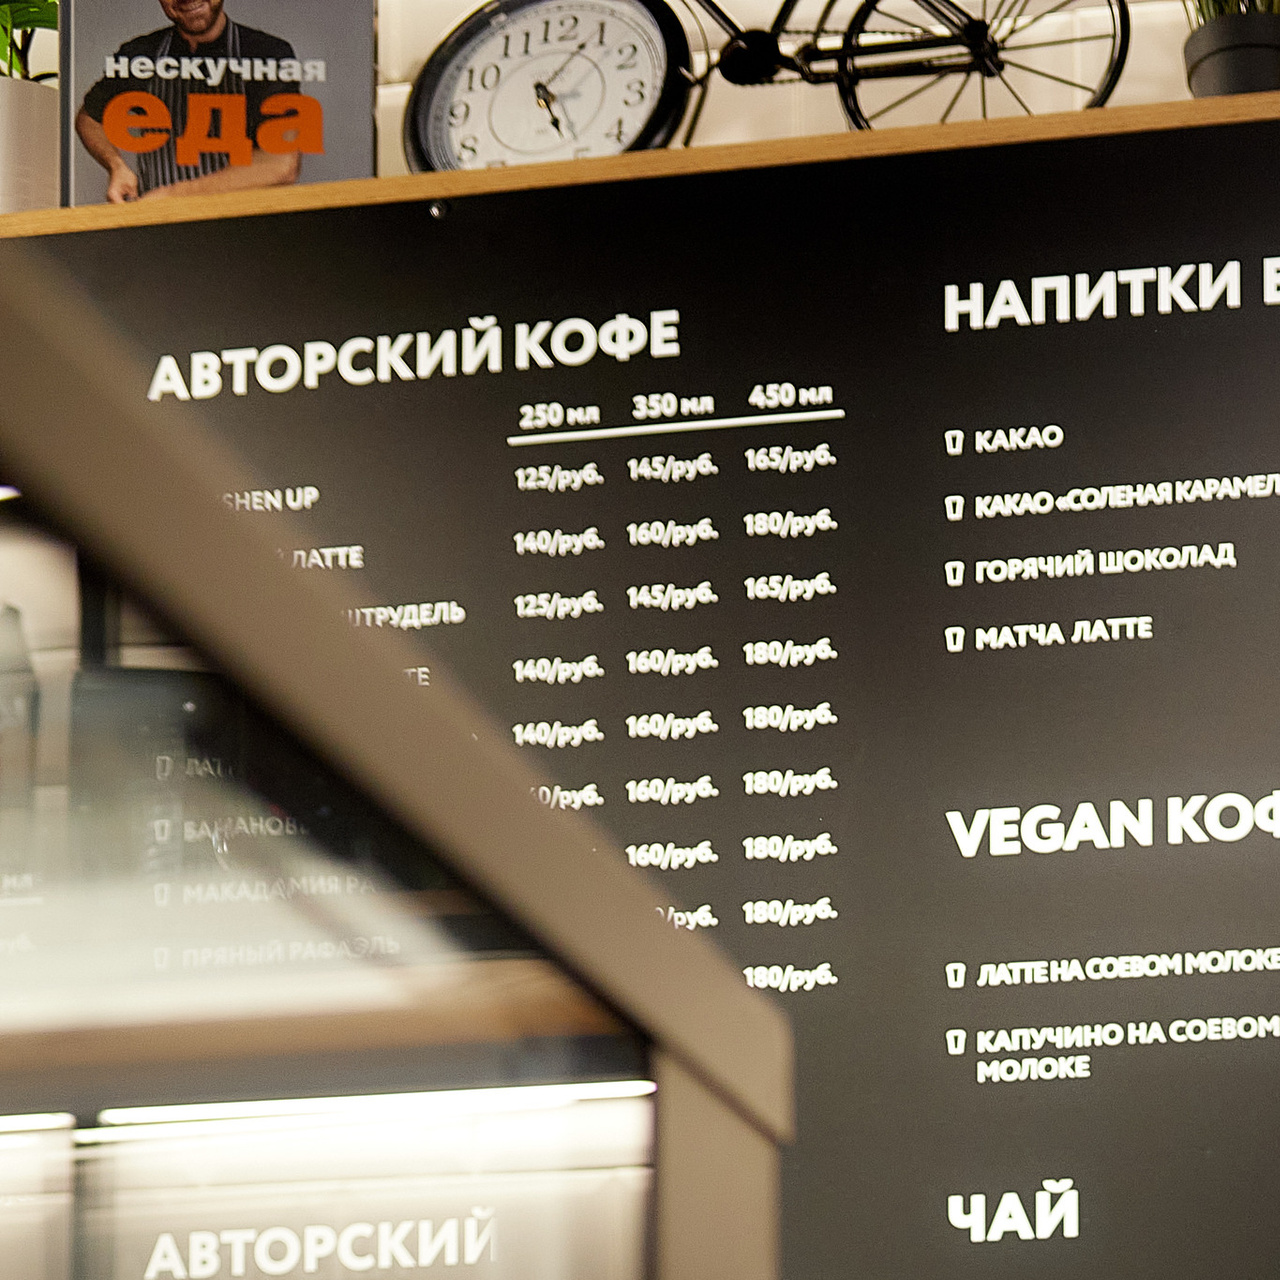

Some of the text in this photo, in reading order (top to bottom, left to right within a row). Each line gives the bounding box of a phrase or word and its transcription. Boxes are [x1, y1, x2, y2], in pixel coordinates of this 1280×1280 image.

[502, 31, 531, 59] 11
[541, 16, 579, 43] 12
[593, 22, 606, 45] 1
[104, 55, 326, 82] нескучная
[617, 43, 638, 69] 2
[466, 65, 501, 91] 10
[624, 78, 644, 107] 3
[103, 91, 325, 166] еда
[448, 101, 469, 128] 9
[606, 119, 623, 145] 4
[458, 137, 477, 162] 8
[945, 261, 1240, 331] НАПИТКИ
[147, 310, 680, 402] АВТОРСКИЙ КОФЕ
[519, 383, 832, 429] 250 мл 350 мл 450 мл
[976, 425, 1063, 453] КАКАО
[515, 444, 836, 492] 125/руб. 145/руб. 165/руб.
[286, 487, 319, 510] UP
[976, 491, 1054, 518] КАКАО
[514, 527, 604, 556] 140/руб.
[627, 518, 718, 547] 160/руб.
[744, 509, 837, 538] 180/руб.
[976, 549, 1094, 583] ГОРЯЧИЙ
[1099, 543, 1236, 573] ШОКОЛАД
[514, 591, 603, 619] 125/руб.
[627, 581, 718, 610] 145/руб.
[744, 572, 836, 602] 165/руб.
[976, 623, 1065, 650] МАТЧА
[1071, 616, 1152, 643] ЛАТТЕ
[513, 638, 837, 684] 140/руб. 160/руб. 180/руб.
[512, 702, 837, 748] 140/руб. 160/руб. 180/руб.
[530, 768, 837, 811] 0/руб. 160/руб. 180/руб.
[946, 799, 1152, 857] VEGAN
[625, 833, 837, 870] 160/руб. 180/руб.
[742, 897, 838, 926] 180/руб.
[743, 963, 838, 992] 180/руб.
[977, 961, 1049, 986] ЛАТТЕ
[1050, 959, 1086, 982] НА
[1085, 953, 1182, 979] СОЕВОМ
[977, 1024, 1124, 1053] КАПУЧИНО
[1128, 1022, 1167, 1044] НА
[1169, 1015, 1280, 1042] СОЕВОМ
[977, 1055, 1090, 1083] МОЛОКЕ
[948, 1179, 1078, 1242] ЧАЙ
